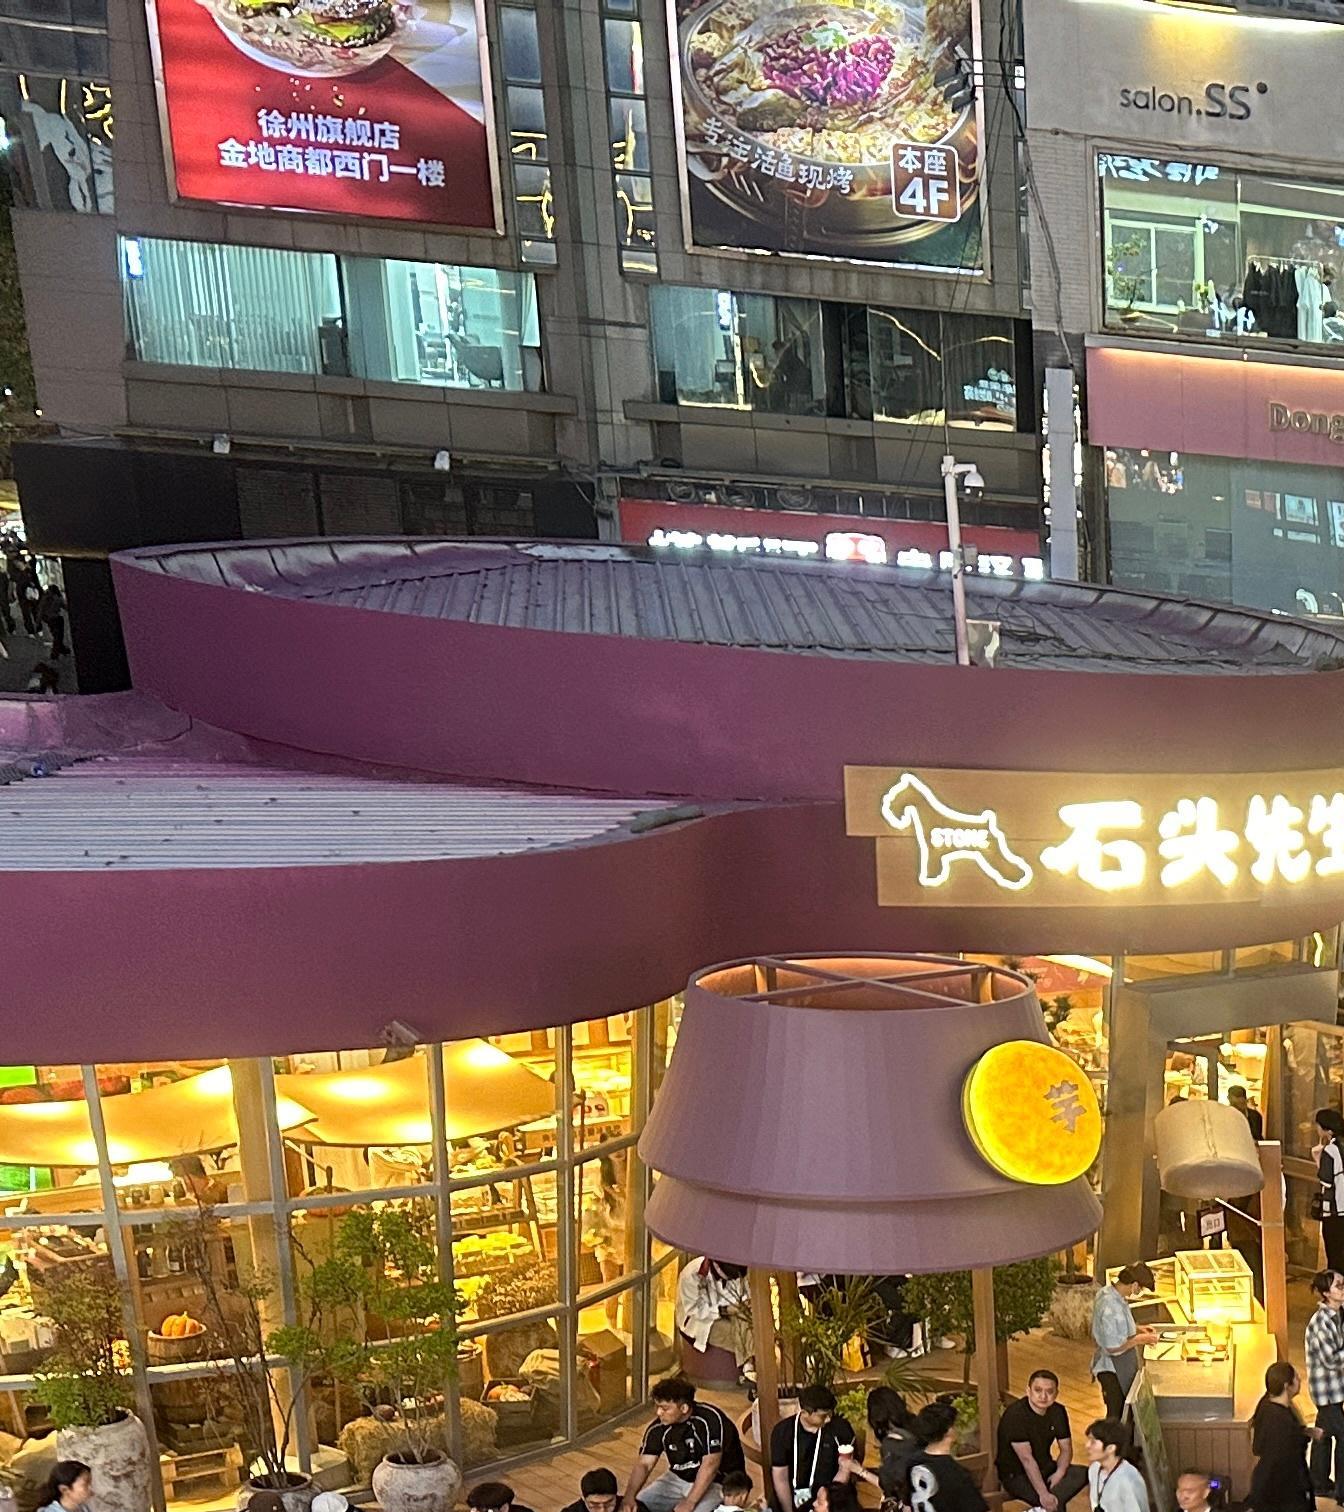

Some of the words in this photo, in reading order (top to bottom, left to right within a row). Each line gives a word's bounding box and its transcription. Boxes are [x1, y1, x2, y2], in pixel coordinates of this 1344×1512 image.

[257, 107, 401, 152] 徐州旗舰店
[218, 140, 447, 189] 金地商都西门一楼
[701, 117, 854, 195] 专注活鱼现烤
[898, 148, 948, 176] 本座
[899, 176, 950, 216] 4F
